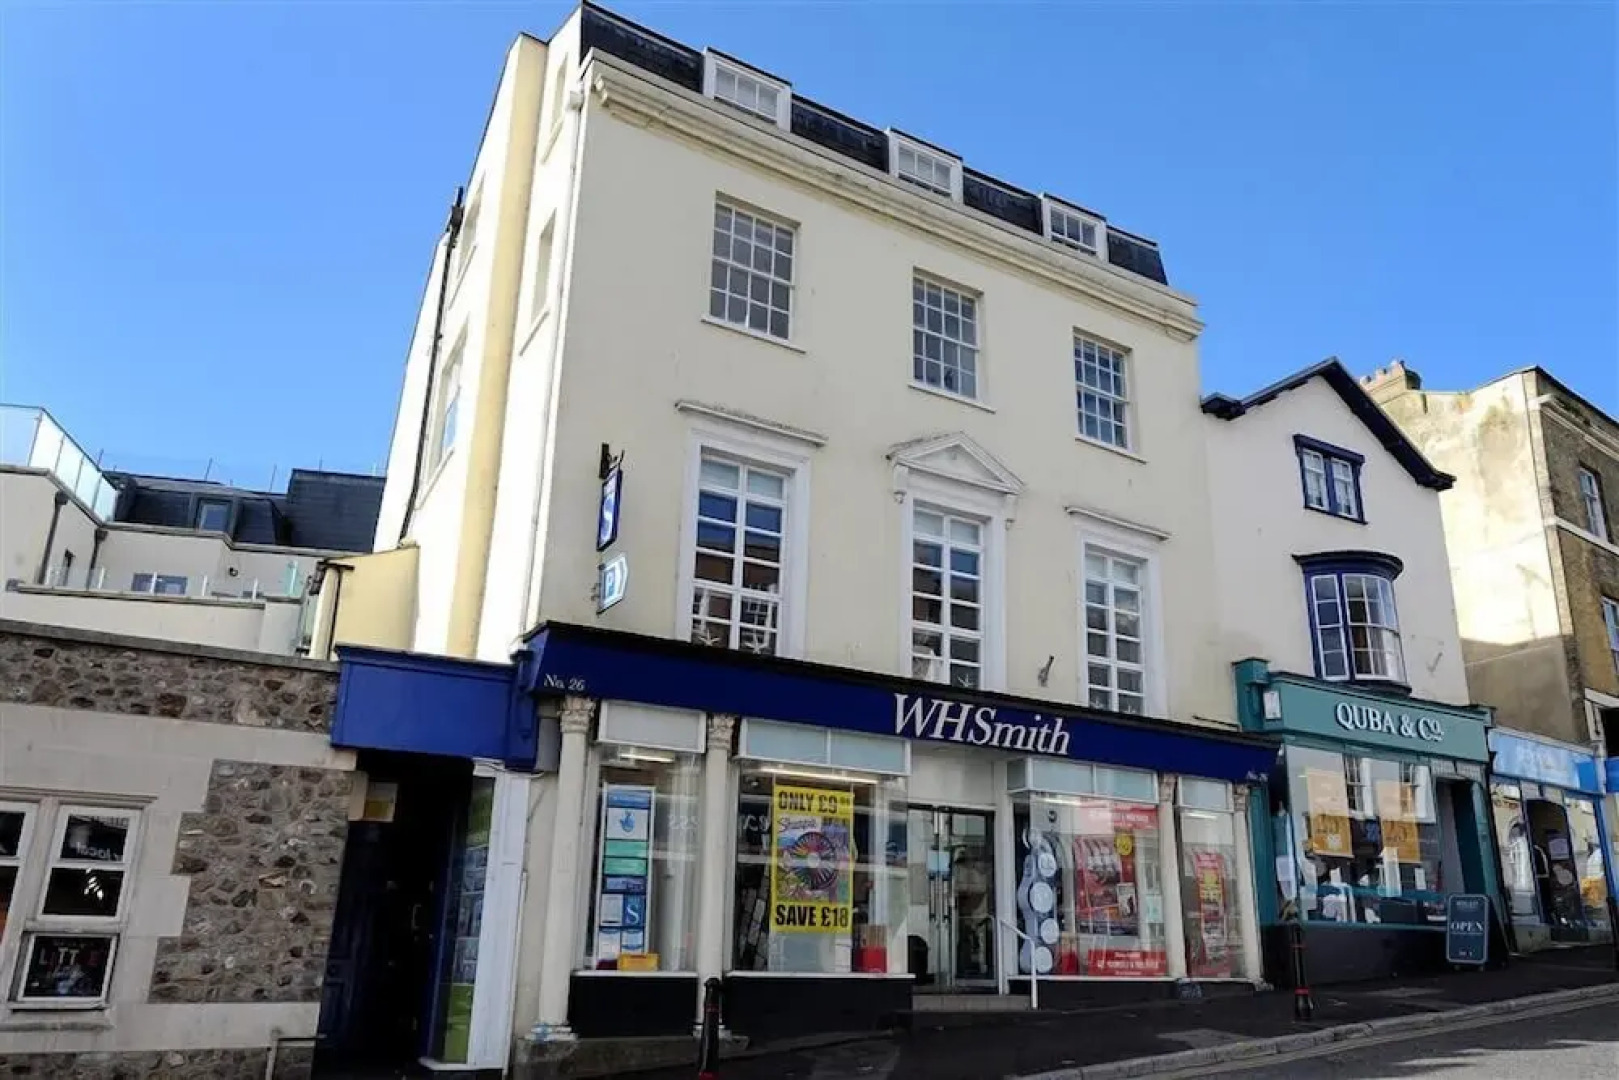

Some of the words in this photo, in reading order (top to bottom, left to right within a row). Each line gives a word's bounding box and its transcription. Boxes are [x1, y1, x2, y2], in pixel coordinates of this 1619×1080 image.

[894, 692, 1070, 755] WHSmith
[1336, 702, 1397, 735] QUBA
[1401, 713, 1417, 738] &
[778, 791, 814, 811] ONLY
[776, 904, 817, 926] SAVE
[821, 907, 849, 928] £18
